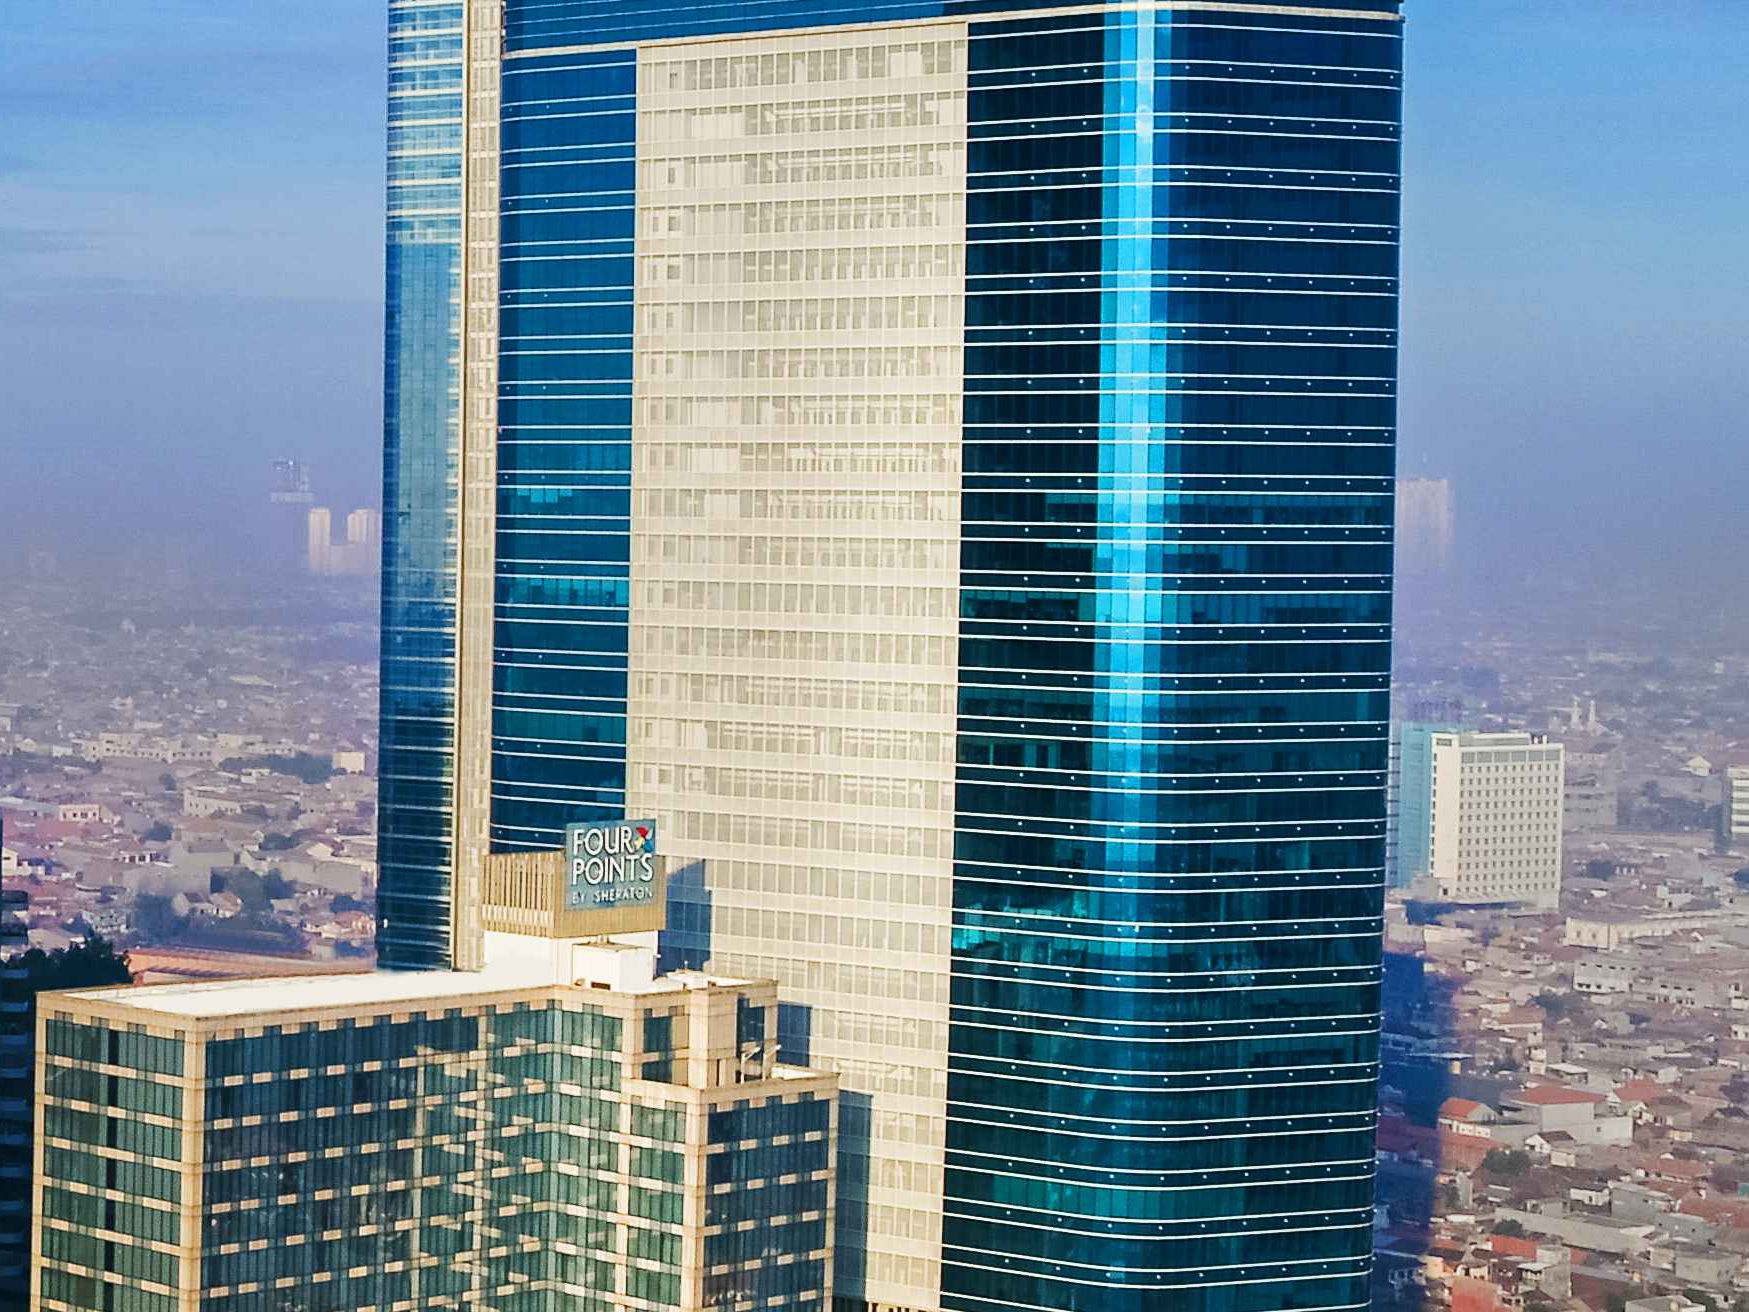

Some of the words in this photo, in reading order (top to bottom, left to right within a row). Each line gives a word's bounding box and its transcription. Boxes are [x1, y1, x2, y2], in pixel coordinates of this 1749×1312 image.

[572, 825, 633, 857] FOUR
[572, 853, 653, 886] POINTS
[572, 892, 585, 905] BY
[593, 886, 653, 904] SHERATON
